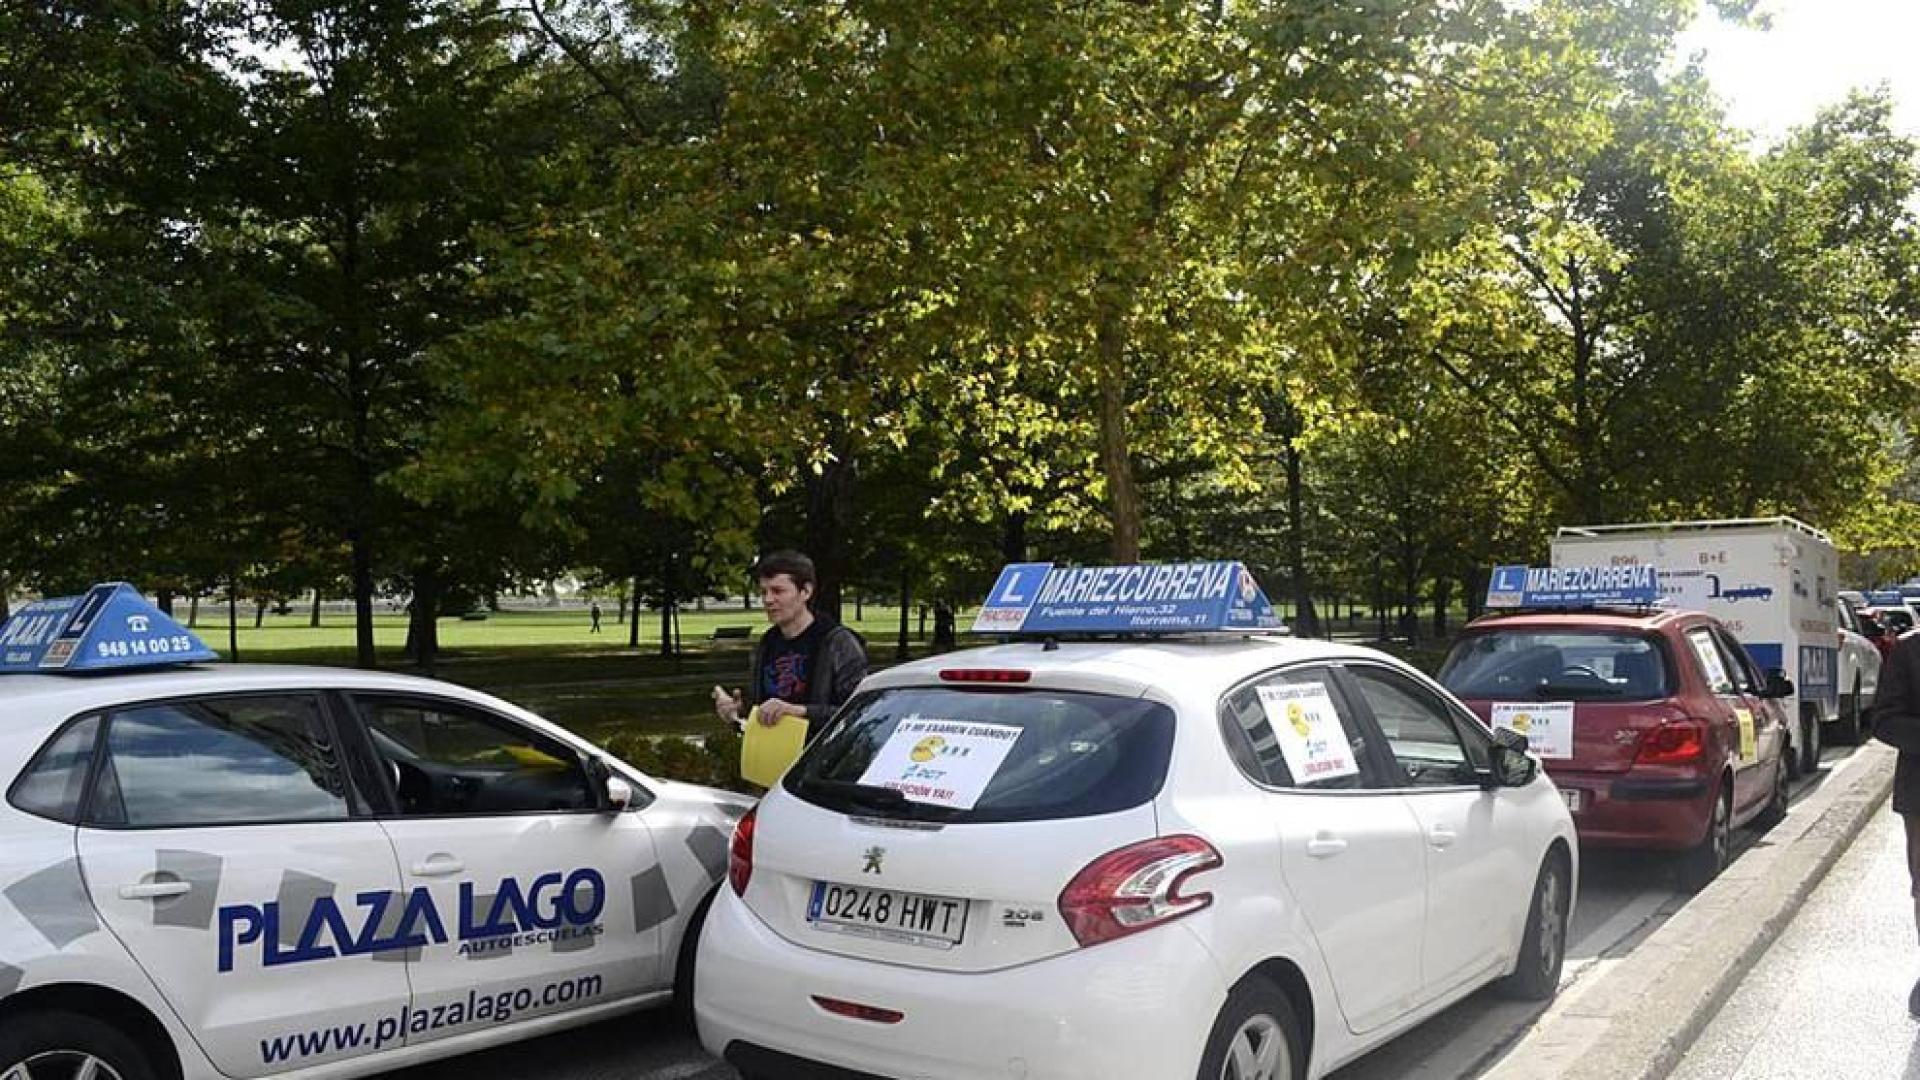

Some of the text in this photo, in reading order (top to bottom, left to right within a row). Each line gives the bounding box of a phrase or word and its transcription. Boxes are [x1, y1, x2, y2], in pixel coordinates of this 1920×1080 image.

[1000, 571, 1024, 602] L
[1037, 563, 1232, 604] MARIEZCURRENA
[1498, 570, 1516, 590] L
[1526, 566, 1651, 592] MARIEZCURRENA
[1040, 606, 1085, 618] Fuente
[1088, 605, 1111, 616] del
[98, 636, 190, 657] 948 14 00 25
[218, 867, 607, 973] PLAZA LAGO
[825, 887, 960, 934] 0248 HWT
[458, 923, 604, 956] AUTOESCUELAS
[260, 972, 602, 1064] www.plazalago.com
